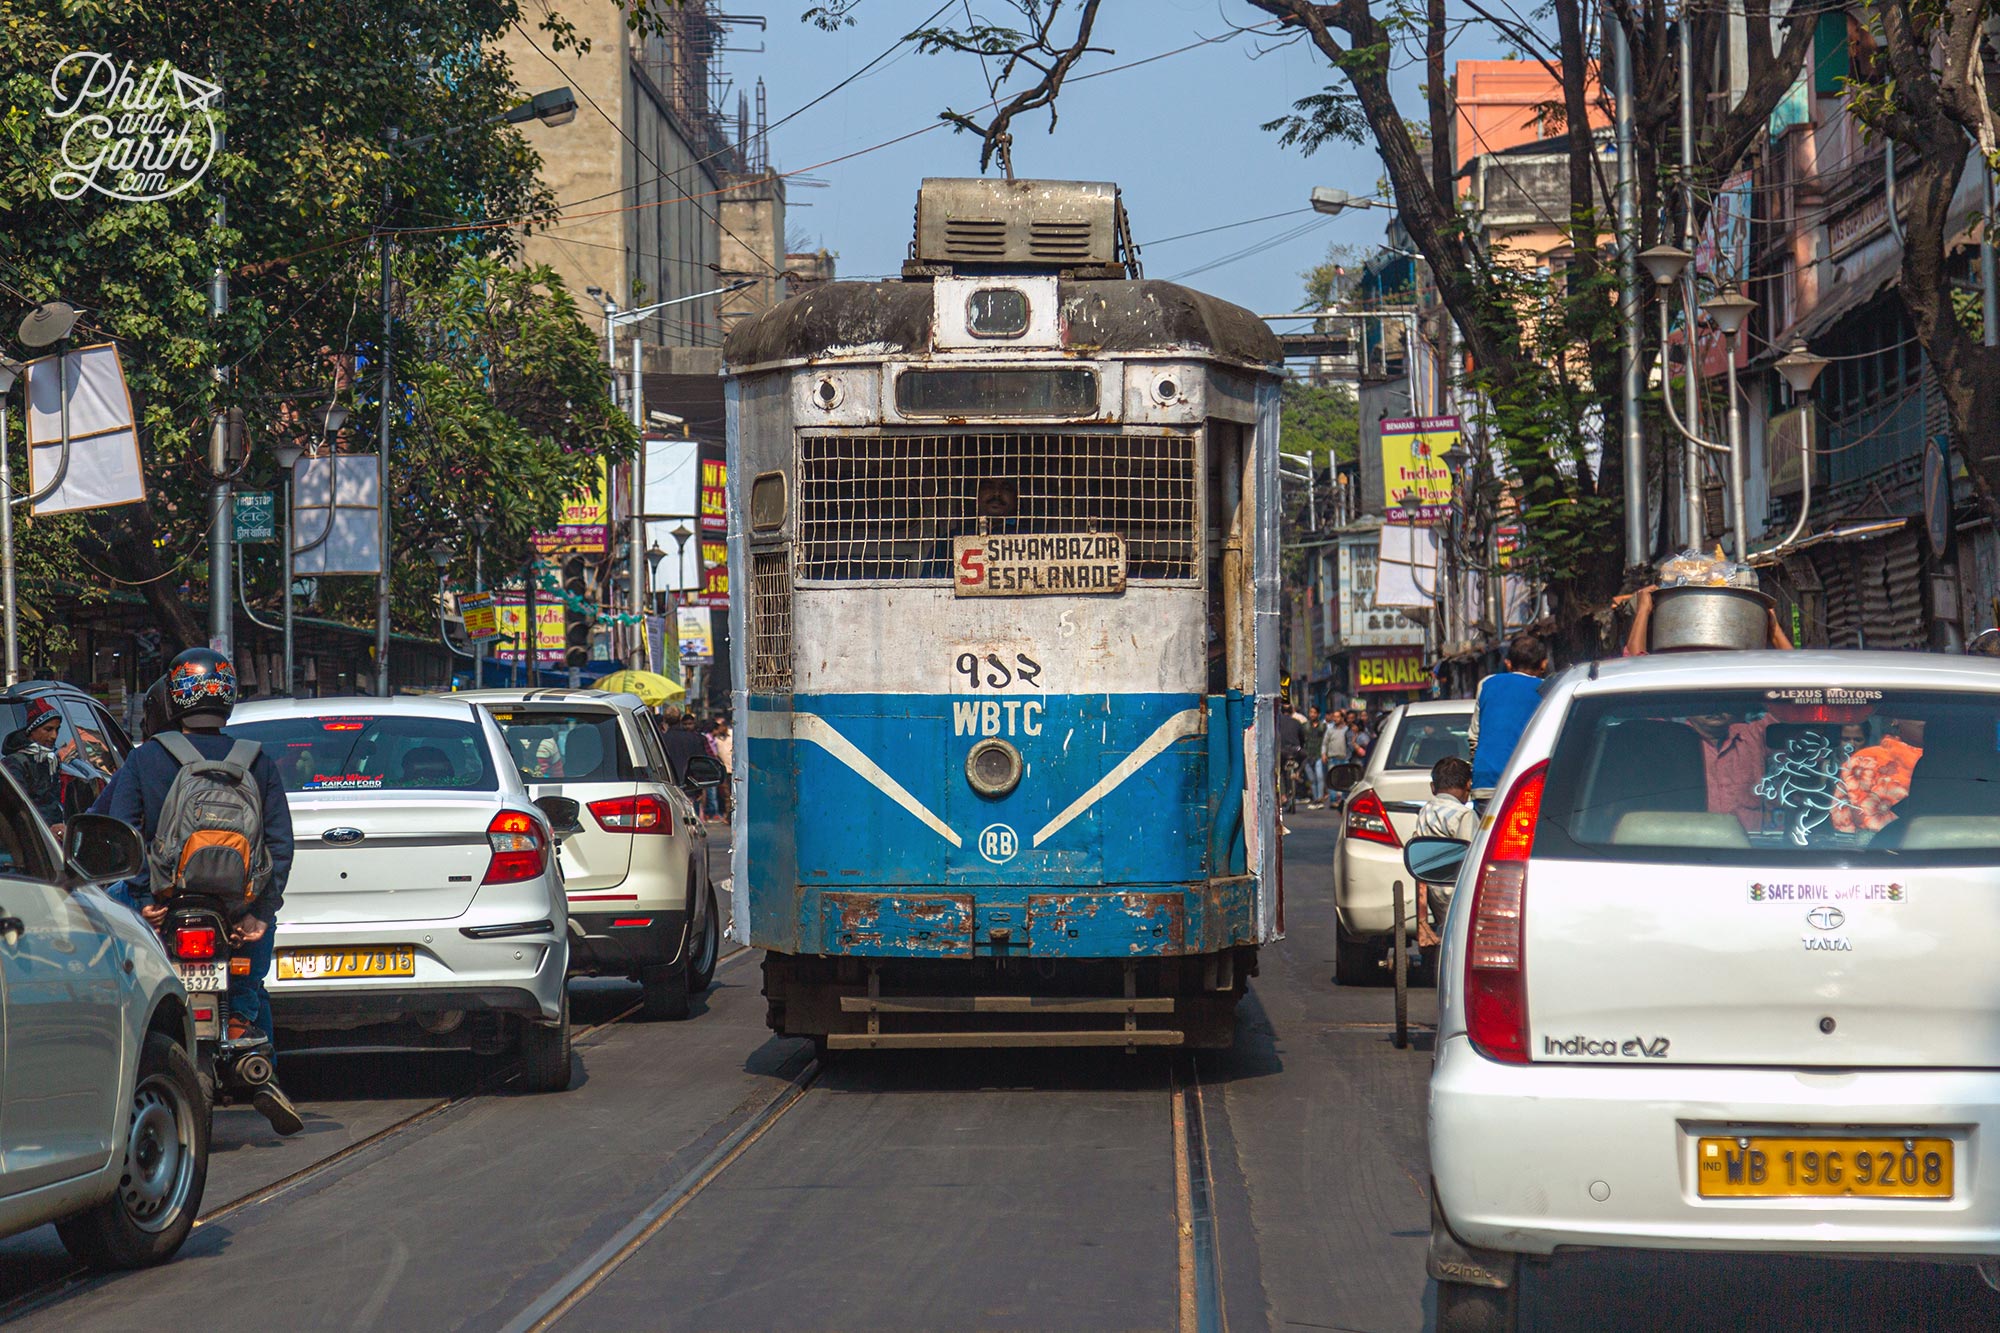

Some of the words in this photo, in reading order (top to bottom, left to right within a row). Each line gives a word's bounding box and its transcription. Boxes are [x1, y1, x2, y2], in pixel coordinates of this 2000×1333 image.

[1400, 465, 1447, 481] Indian
[1418, 487, 1453, 501] Hous
[988, 537, 1120, 561] SHYAMBAZAR
[960, 548, 985, 585] 5
[988, 565, 1119, 589] ESPLANADE
[956, 653, 1042, 689] ৭১২
[1781, 690, 1822, 699] LEXUS
[1826, 688, 1883, 699] MOTORS
[953, 701, 1042, 736] WBTC
[986, 832, 1012, 856] RB
[1768, 884, 1794, 900] SAFE
[1797, 884, 1828, 900] DRIVE
[1864, 884, 1886, 900] LIFE
[1803, 937, 1853, 951] TATA
[200, 964, 216, 977] 08
[1544, 1035, 1617, 1056] Indica
[1703, 1161, 1722, 1172] IND
[1726, 1149, 1768, 1186] WB
[1784, 1150, 1843, 1186] 19G
[1855, 1150, 1942, 1186] 9208
